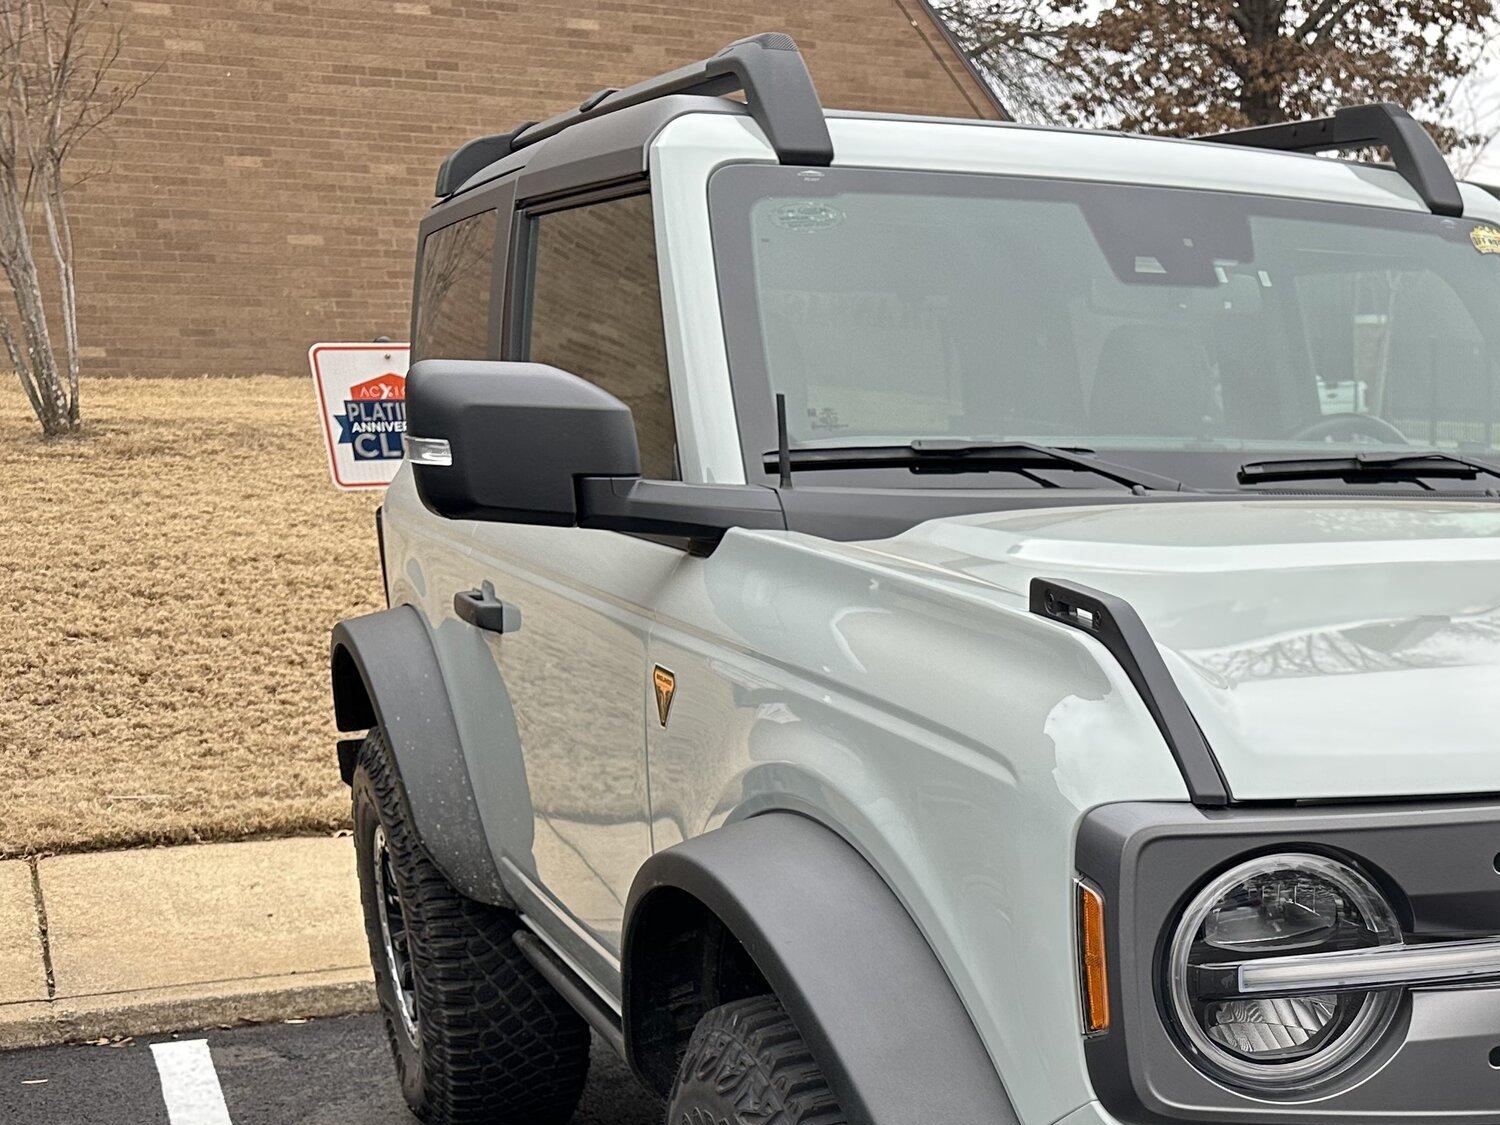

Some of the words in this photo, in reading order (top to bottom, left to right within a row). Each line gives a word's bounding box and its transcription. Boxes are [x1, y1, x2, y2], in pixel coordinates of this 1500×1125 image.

[359, 383, 406, 400] ACXI
[347, 402, 407, 422] PLATI
[351, 421, 407, 434] ANNIVE
[354, 432, 407, 458] CL
